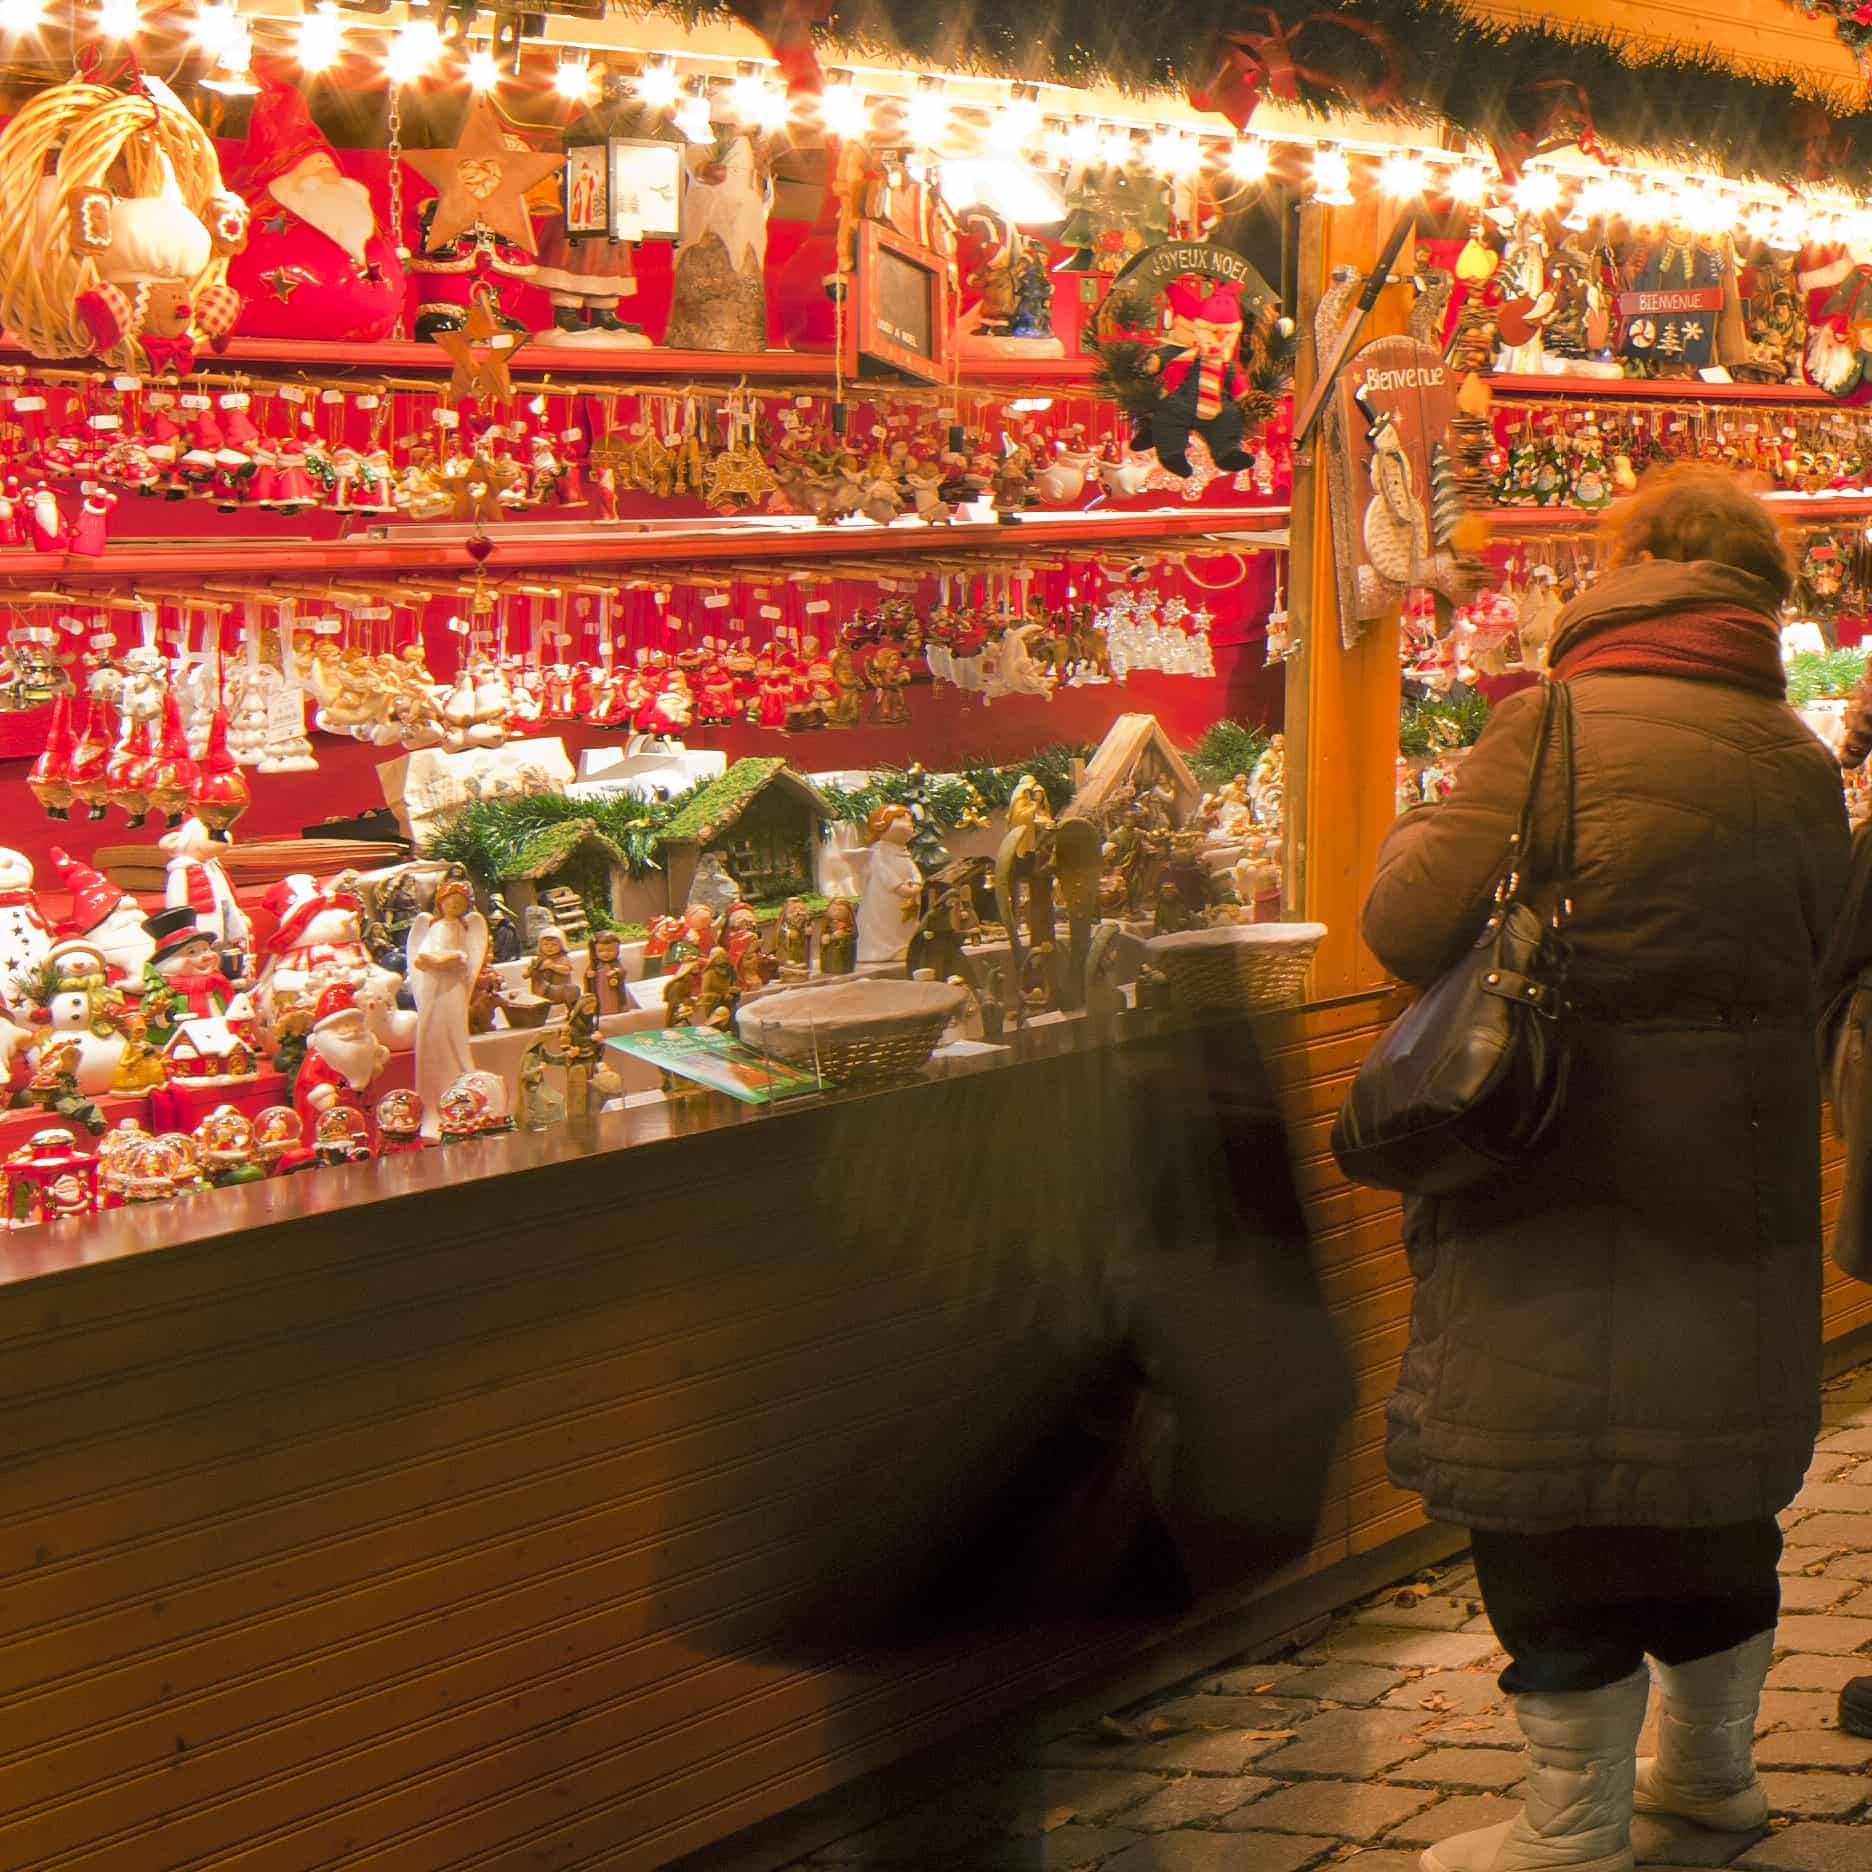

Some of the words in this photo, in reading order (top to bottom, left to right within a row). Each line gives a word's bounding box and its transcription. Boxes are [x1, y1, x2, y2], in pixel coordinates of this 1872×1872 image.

[1152, 247, 1208, 276] JOYEUX
[1210, 251, 1249, 285] NOEL
[1639, 293, 1705, 312] BIENVENUE
[1366, 367, 1446, 392] Bienvenue
